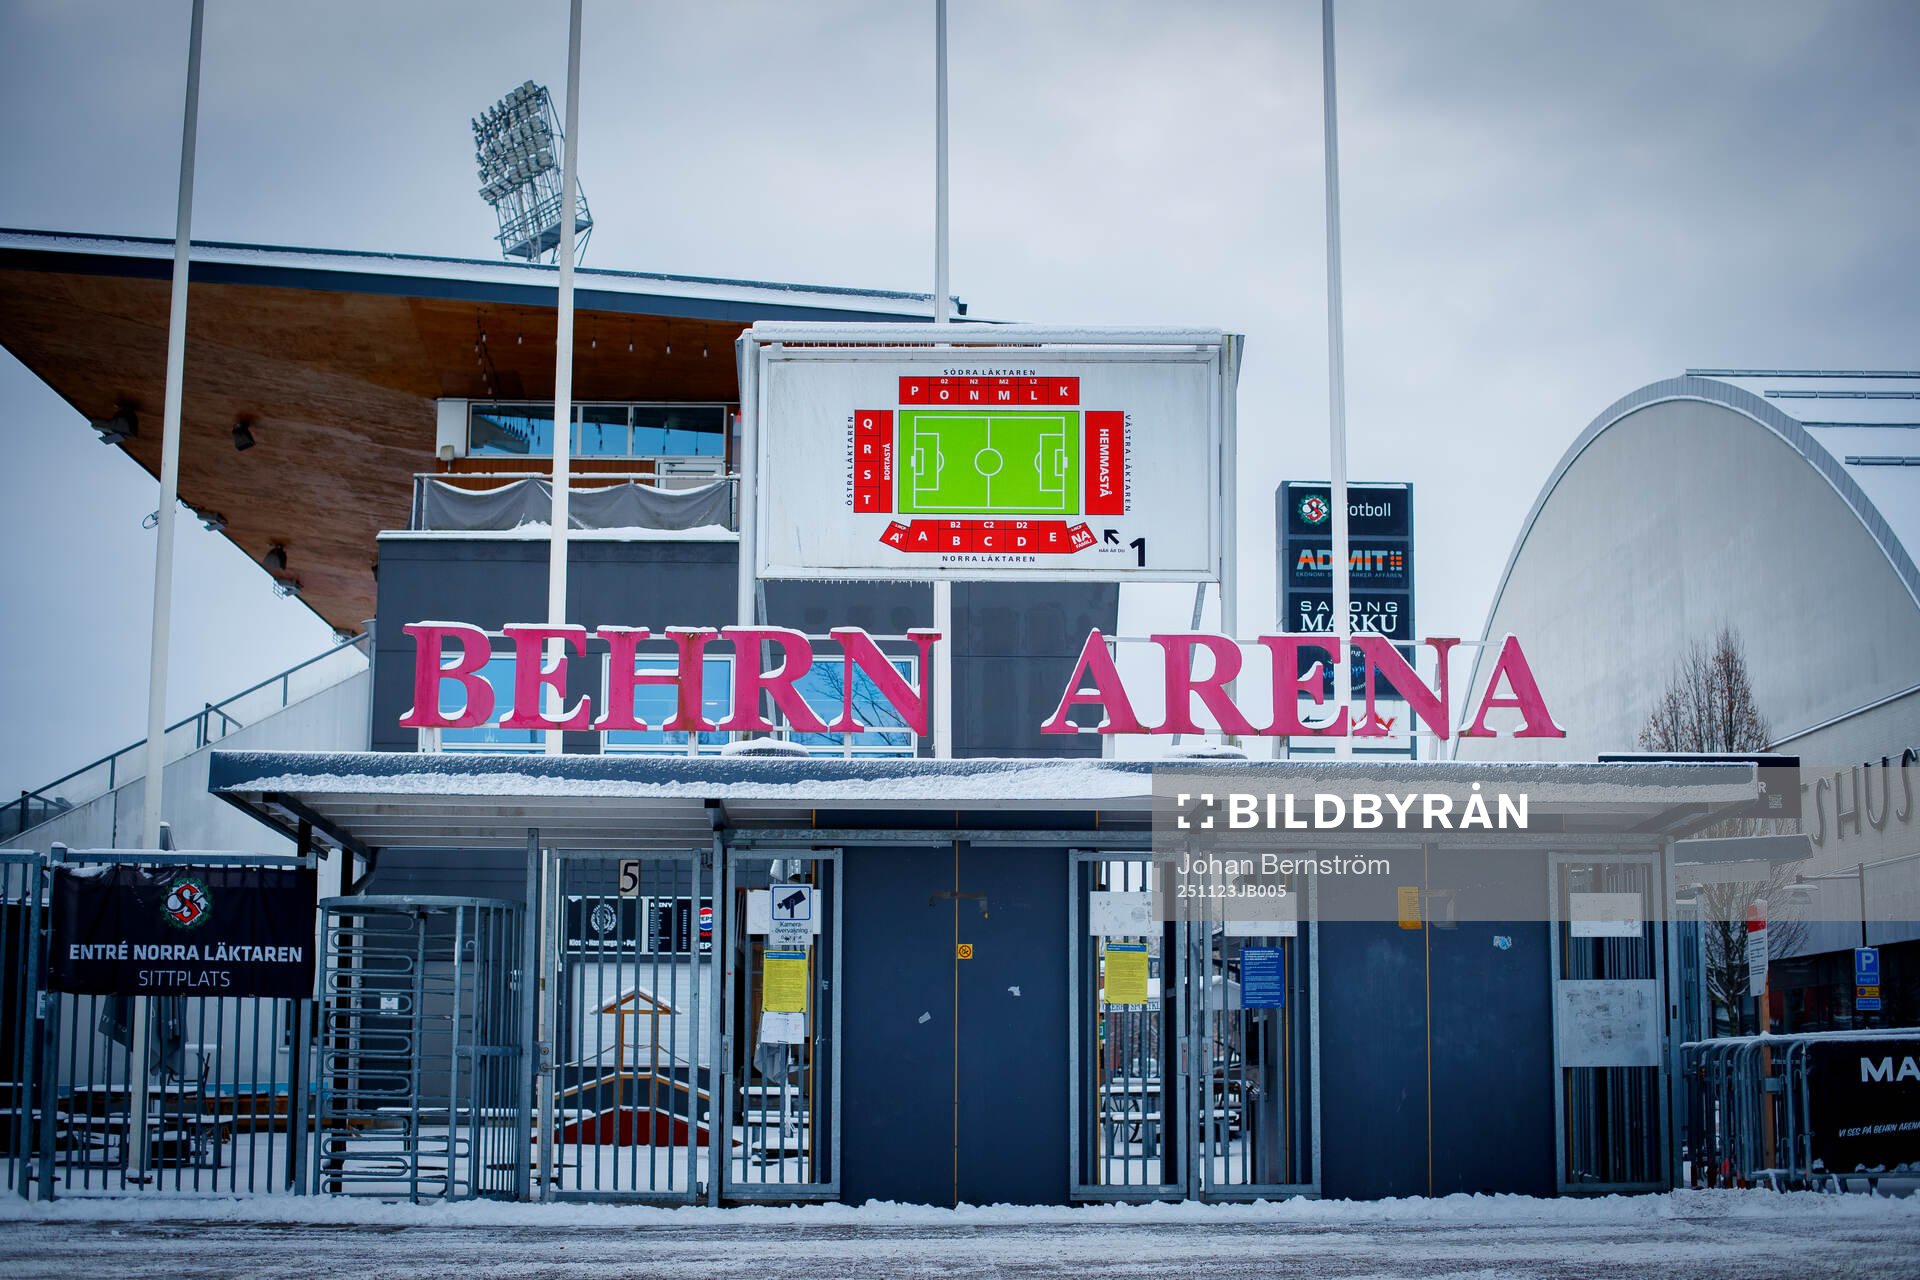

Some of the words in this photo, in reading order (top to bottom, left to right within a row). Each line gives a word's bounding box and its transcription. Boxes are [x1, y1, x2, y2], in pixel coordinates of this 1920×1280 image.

[943, 368, 979, 376] SÖDRA
[981, 368, 1036, 376] LÄKTAREN
[911, 386, 919, 396] P
[939, 390, 950, 400] O
[969, 390, 979, 400] N
[997, 390, 1011, 400] M
[1030, 391, 1038, 400] L
[1059, 386, 1069, 396] K
[863, 418, 873, 430] Q
[863, 444, 872, 454] R
[883, 442, 891, 480] BORTASTÅ
[1099, 428, 1113, 497] HEMMASTÅ
[863, 469, 872, 480] S
[845, 473, 853, 506] ÖSTRA
[863, 494, 871, 505] T
[1347, 502, 1391, 517] otboll
[950, 521, 961, 529] B2
[983, 521, 994, 529] C2
[1016, 521, 1028, 529] D2
[917, 531, 928, 541] A
[952, 535, 961, 546] B
[984, 536, 993, 547] C
[1017, 536, 1027, 547] D
[1050, 532, 1056, 542] E
[1071, 530, 1090, 545] NA
[1129, 537, 1146, 567] 1
[981, 555, 1035, 563] LÄKTAREN
[1300, 600, 1398, 612] SAONG
[399, 620, 942, 737] BEHRN
[1040, 628, 1566, 740] ARENA
[620, 862, 639, 893] 5
[69, 940, 128, 961] ENTRÉ
[133, 944, 199, 961] NORRA
[204, 941, 303, 962] LÄKTAREN
[1861, 952, 1875, 972] P
[139, 970, 230, 987] SITTPLATS
[1860, 1056, 1920, 1082] MA
